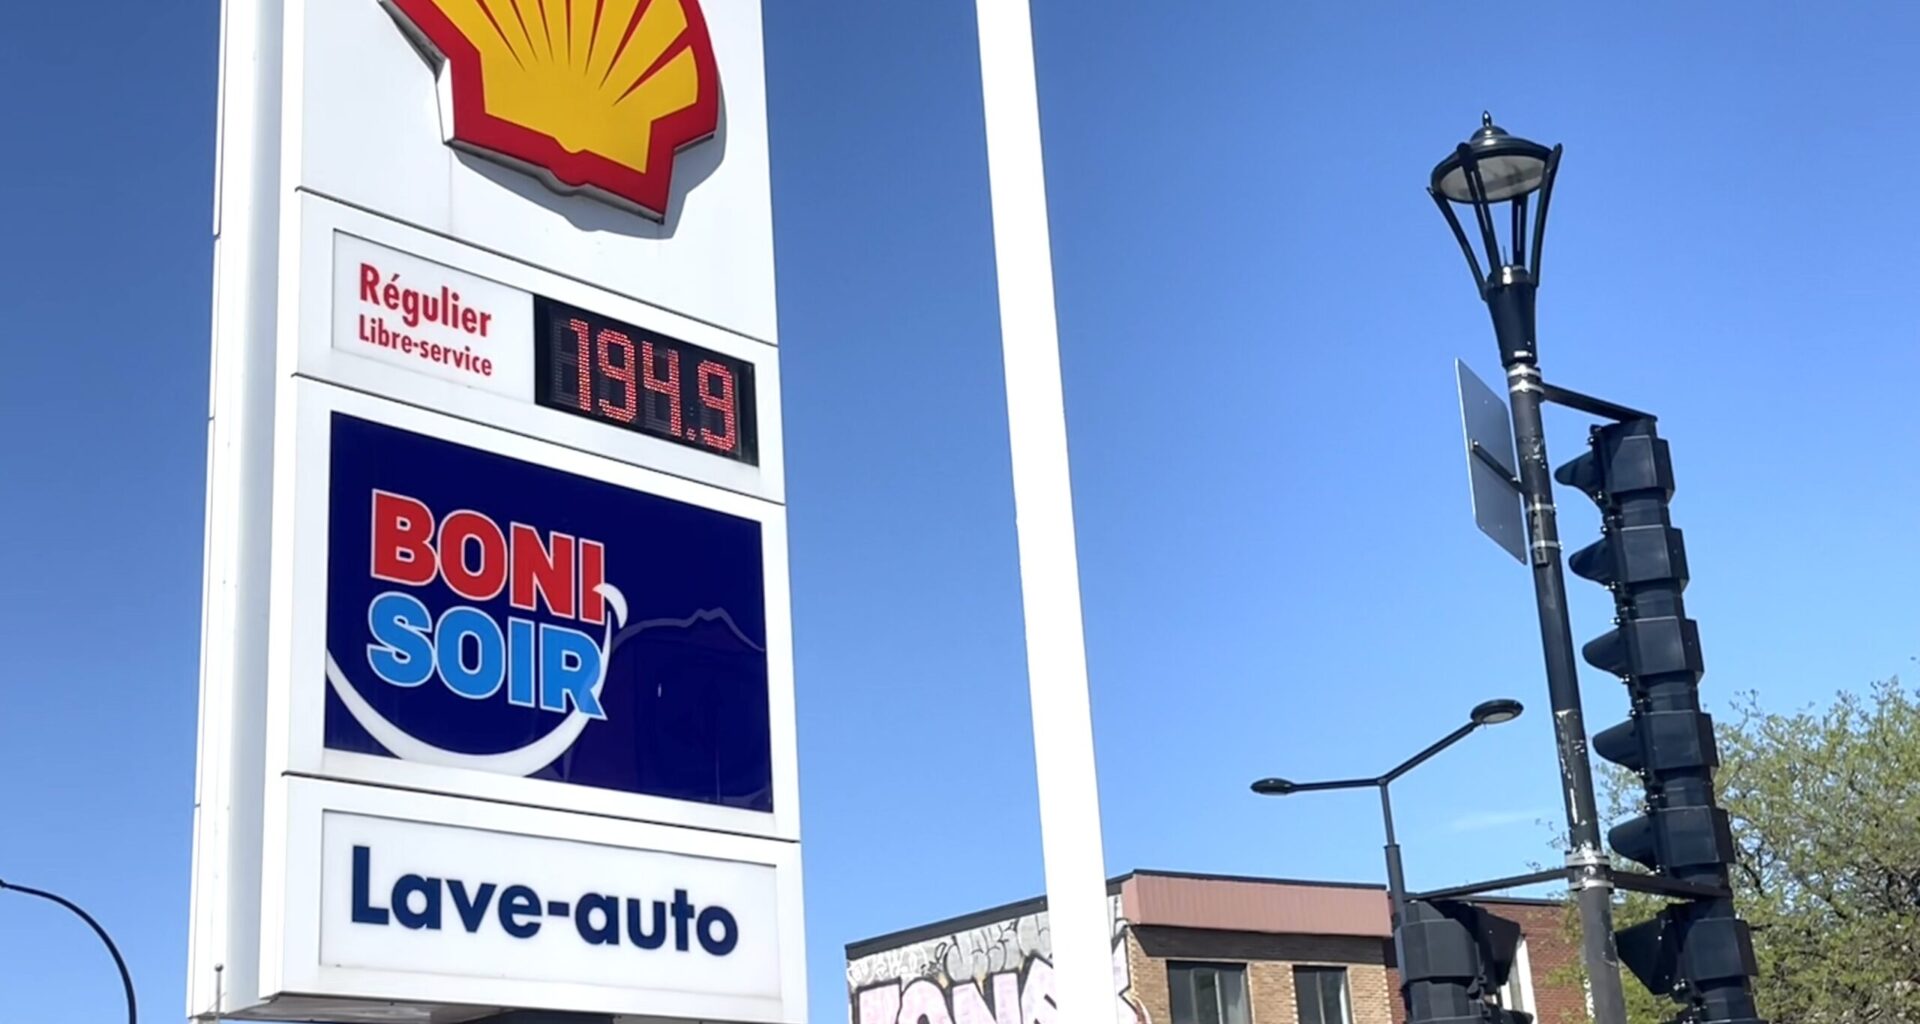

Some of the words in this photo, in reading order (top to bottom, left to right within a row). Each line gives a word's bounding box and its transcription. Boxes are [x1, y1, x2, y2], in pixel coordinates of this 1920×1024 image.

[359, 263, 492, 337] Régulier
[359, 314, 492, 376] Libre-service
[571, 318, 736, 451] 194.9
[370, 488, 605, 625] BONI
[366, 591, 608, 720] SOIR
[351, 845, 739, 957] Lave-auto
